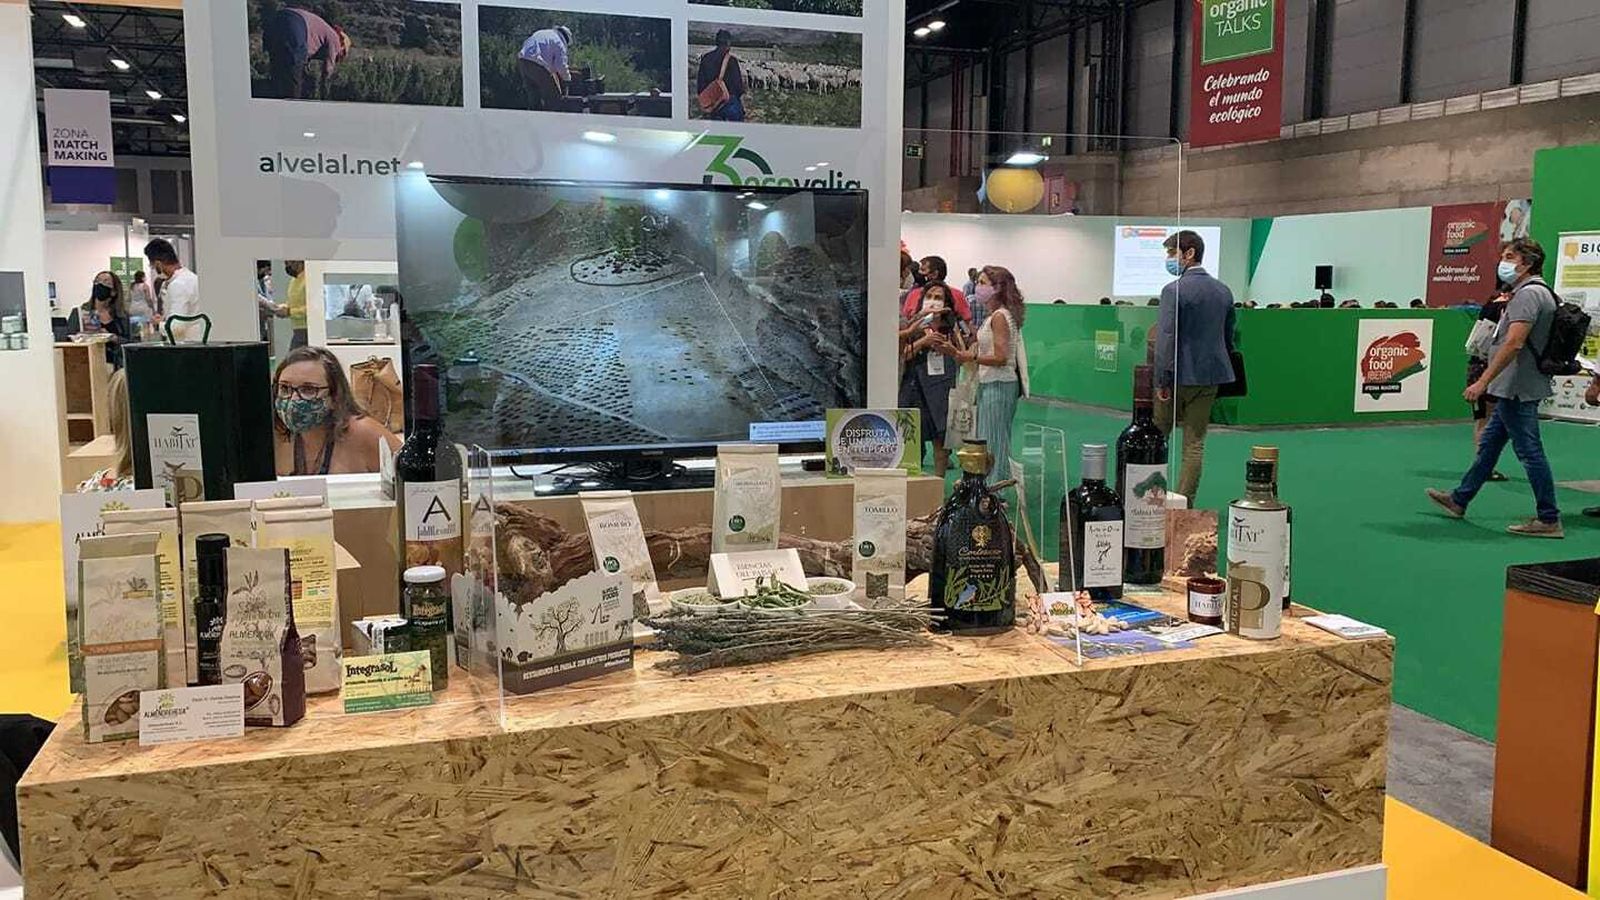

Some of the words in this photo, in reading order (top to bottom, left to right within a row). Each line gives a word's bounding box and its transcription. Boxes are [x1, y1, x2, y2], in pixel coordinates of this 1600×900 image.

[1210, 0, 1267, 19] organic
[1214, 13, 1262, 36] TALKS
[1204, 67, 1270, 92] Celebrando
[1209, 91, 1220, 107] el
[1222, 87, 1263, 105] mundo
[1209, 105, 1261, 124] ecológico
[52, 127, 89, 140] ZONA
[53, 139, 98, 150] MATCH
[53, 150, 108, 162] MAKING
[259, 152, 400, 176] alvelal.net
[1447, 229, 1464, 239] food
[1369, 344, 1409, 360] organic
[1369, 357, 1394, 370] food
[154, 433, 198, 450] HABITAT
[845, 428, 890, 438] DISFRUTA
[422, 495, 452, 523] A
